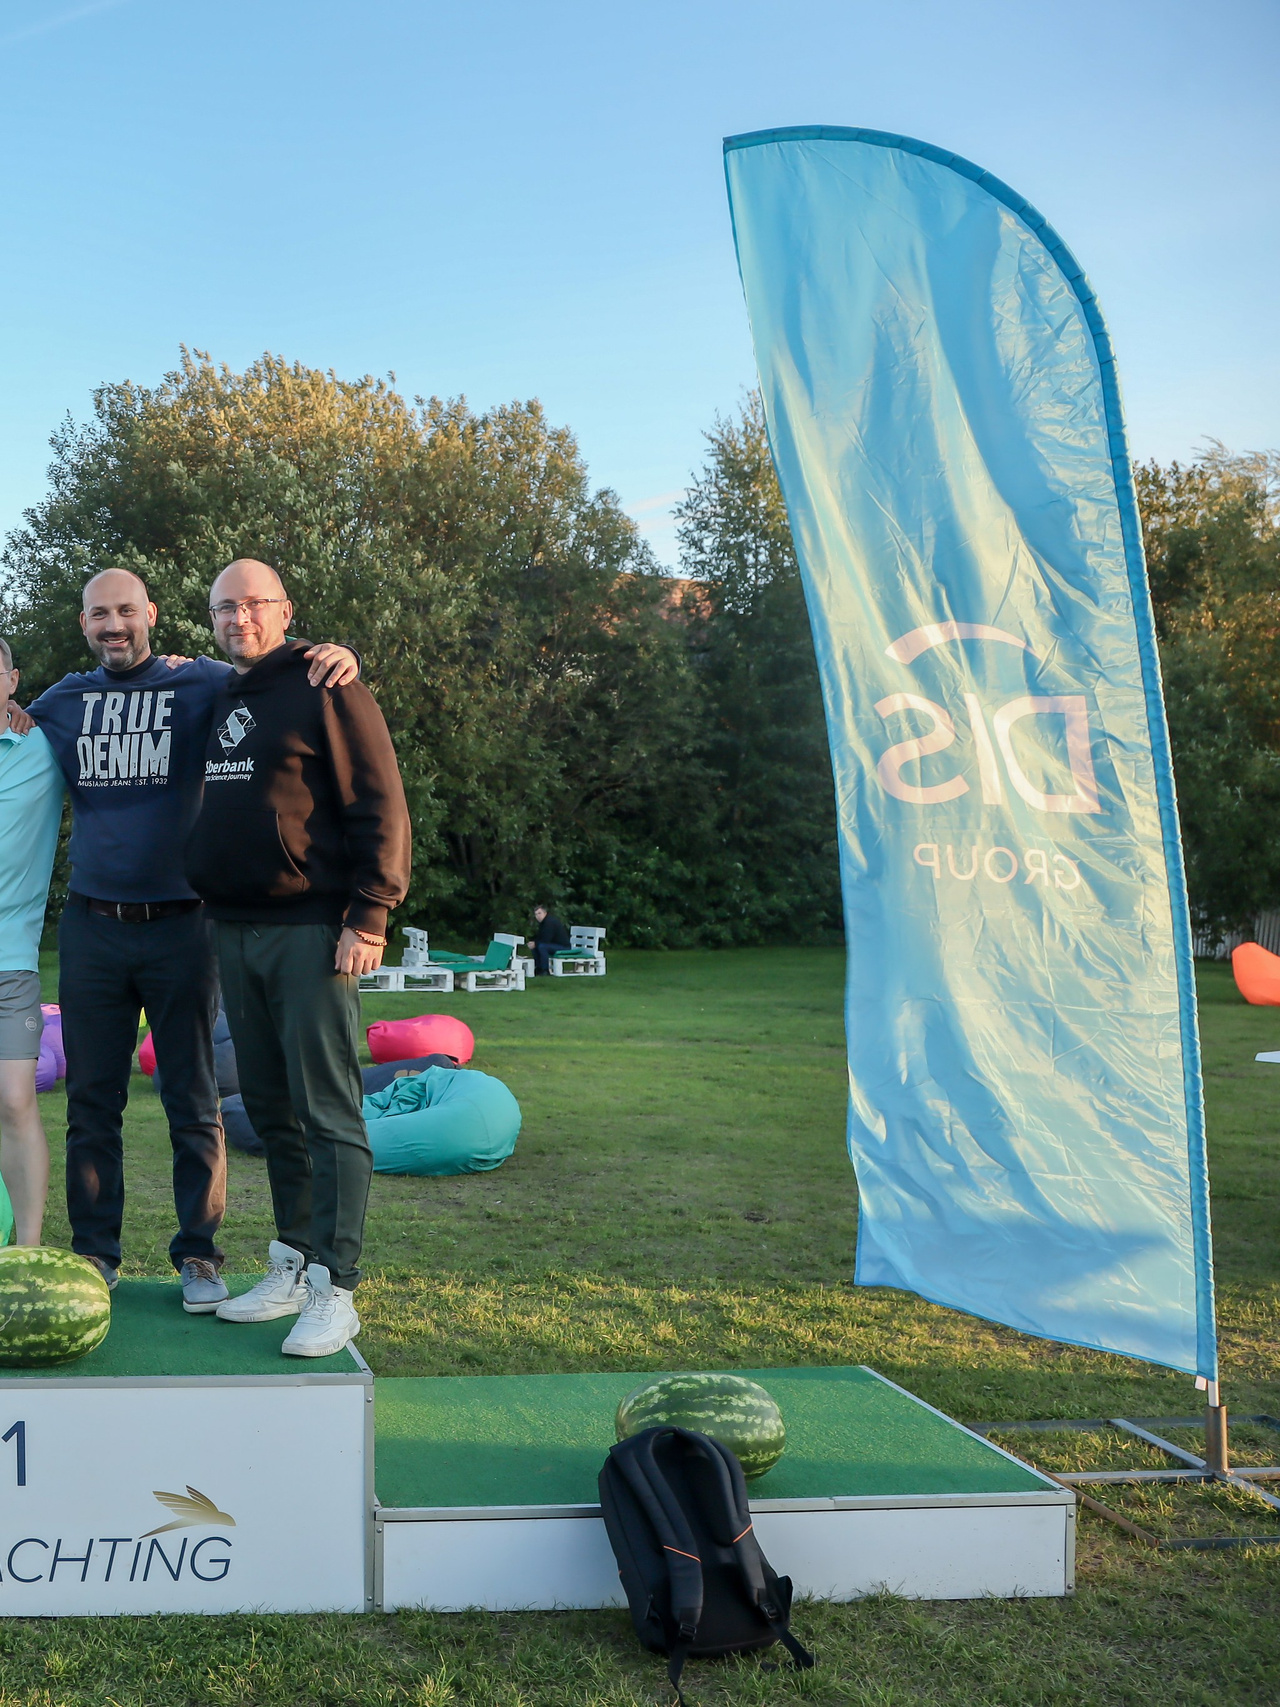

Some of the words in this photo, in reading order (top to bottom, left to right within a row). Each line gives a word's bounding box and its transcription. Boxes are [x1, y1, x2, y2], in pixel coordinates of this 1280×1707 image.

[82, 690, 175, 735] TRUE
[76, 730, 172, 780] DENIM
[205, 756, 255, 774] Sberbank
[77, 780, 109, 788] MUSTANG
[110, 779, 132, 788] JEANS
[151, 777, 168, 785] 1932
[227, 773, 252, 782] Journey
[0, 1420, 27, 1487] 1
